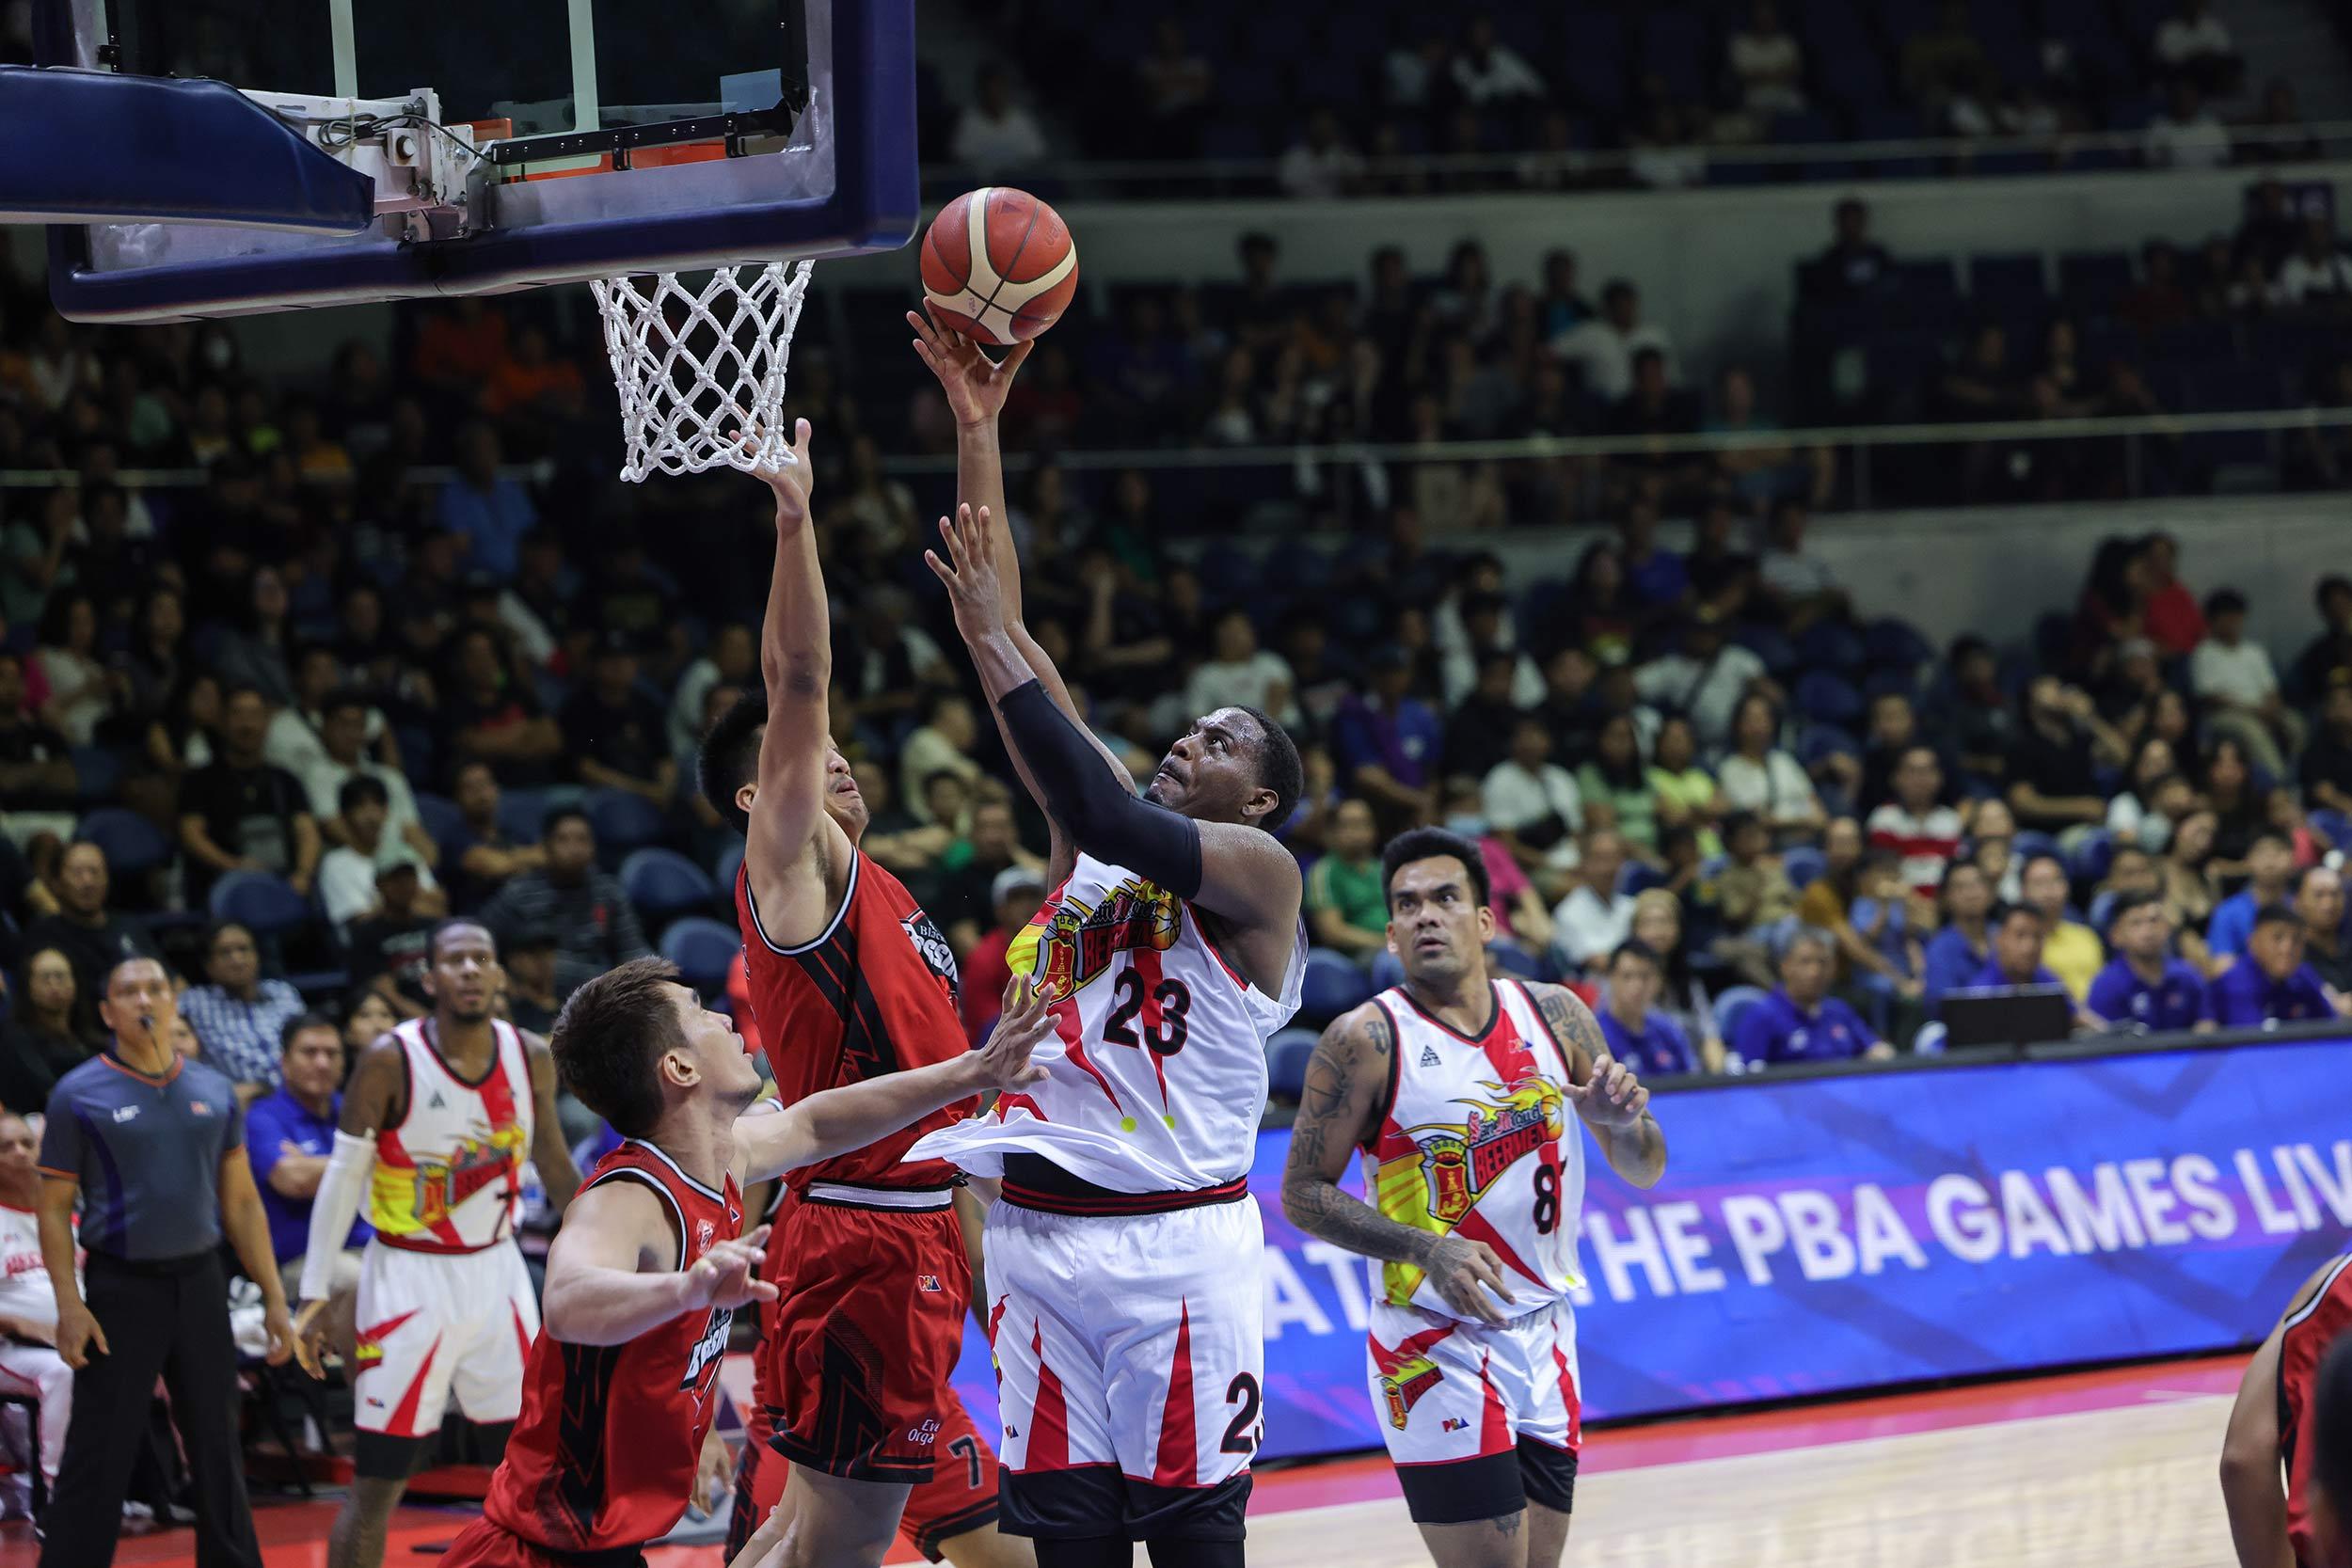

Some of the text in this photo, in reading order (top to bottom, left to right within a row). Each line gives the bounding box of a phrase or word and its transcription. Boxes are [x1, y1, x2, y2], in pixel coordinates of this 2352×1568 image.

[1103, 966, 1191, 1056] 23
[1473, 1119, 1549, 1192] BEERMEN
[1571, 1196, 1727, 1307] HE
[1723, 1180, 1929, 1287] PBA
[1925, 1153, 2237, 1264] GAMES
[946, 1433, 984, 1490] 7
